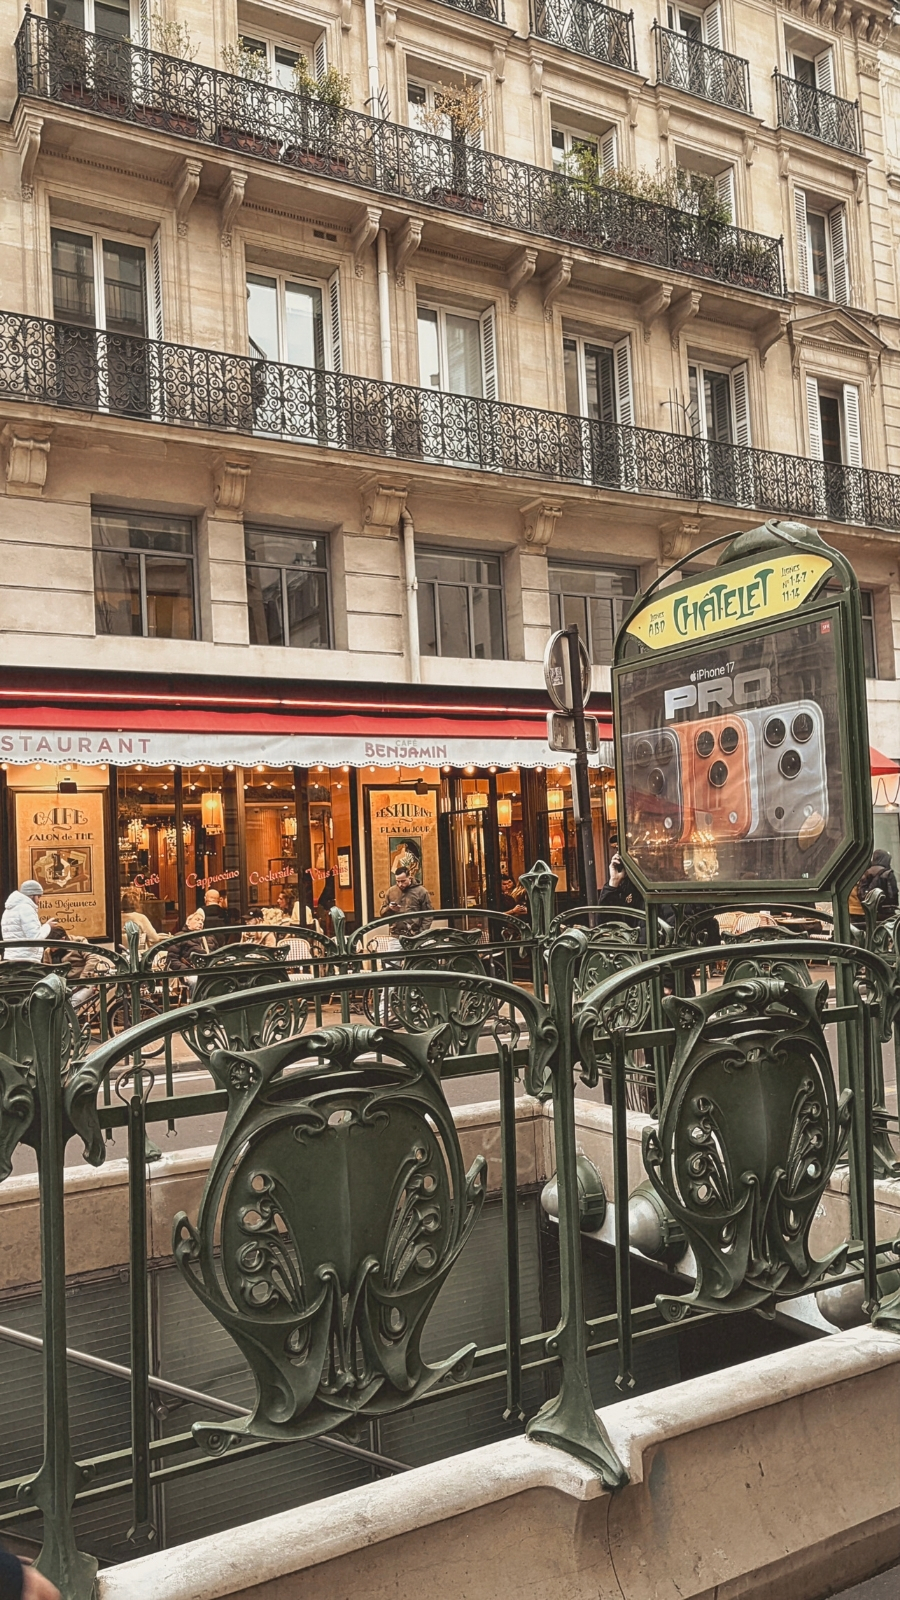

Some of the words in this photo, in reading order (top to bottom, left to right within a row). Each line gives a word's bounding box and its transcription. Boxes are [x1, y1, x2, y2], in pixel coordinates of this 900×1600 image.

[673, 568, 774, 636] CHÂTELET
[696, 665, 725, 681] iPhone
[725, 661, 735, 674] 17
[664, 667, 772, 720] PRO
[1, 735, 151, 754] STAURANT
[365, 742, 447, 758] BENJAMIN
[395, 738, 418, 747] CAFÉ
[26, 833, 59, 841] SALON
[411, 825, 431, 833] JOUR
[134, 873, 161, 888] Café
[186, 869, 240, 889] Cappuccino
[249, 865, 294, 885] Cocktails
[55, 898, 97, 911] Déjeuners
